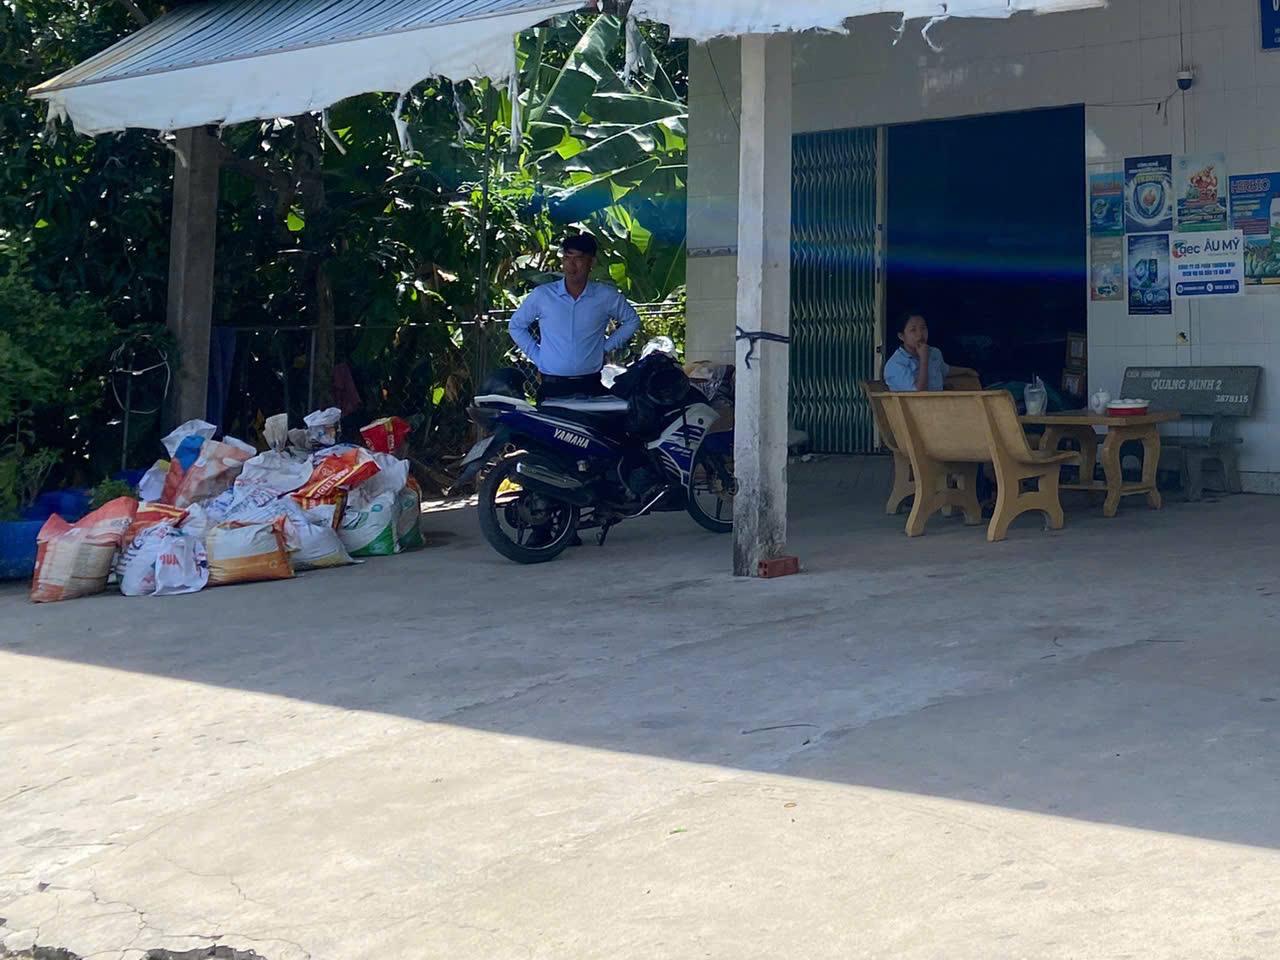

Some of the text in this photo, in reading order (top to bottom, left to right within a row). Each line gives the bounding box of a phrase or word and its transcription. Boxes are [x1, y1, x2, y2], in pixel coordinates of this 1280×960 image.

[1204, 236, 1240, 252] ÂU MỸ
[1151, 379, 1222, 391] QUANG MINH 2
[553, 427, 590, 449] YAMAHA
